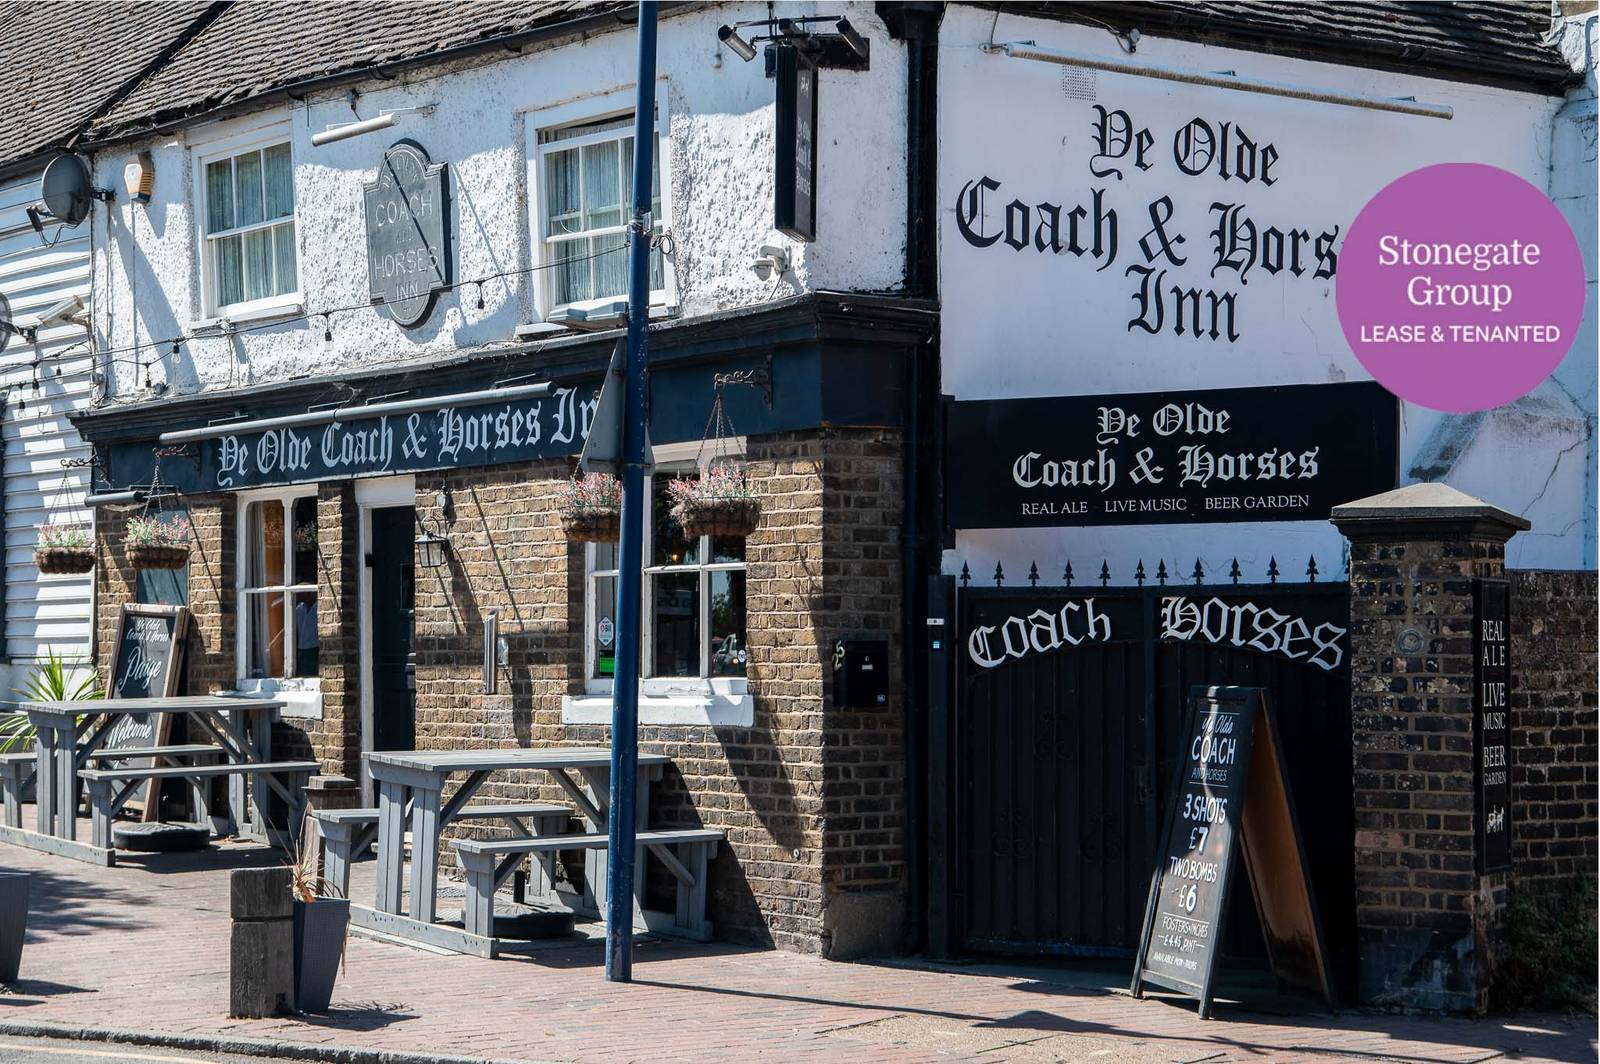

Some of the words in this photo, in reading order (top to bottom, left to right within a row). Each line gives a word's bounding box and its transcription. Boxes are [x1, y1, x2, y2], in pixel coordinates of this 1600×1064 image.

[1090, 104, 1155, 180] Ye
[1173, 117, 1280, 186] Olde
[375, 193, 433, 227] COACH
[956, 176, 1119, 271] Coach
[1138, 194, 1188, 266] &
[1209, 201, 1341, 285] Hors
[374, 245, 439, 279] HORSES
[396, 281, 419, 301] INN
[1125, 264, 1241, 343] Inn
[1096, 405, 1141, 444] Ye
[1153, 402, 1231, 436] Olde
[217, 436, 249, 488] Ye
[256, 427, 313, 474] Olde
[320, 415, 393, 473] Coach
[402, 412, 428, 459] &
[438, 400, 542, 462] Horses
[1012, 449, 1116, 492] Coach
[1128, 446, 1164, 485] &
[1178, 444, 1320, 488] Horses
[1021, 503, 1059, 516] REAL
[1061, 501, 1089, 515] ALE
[1105, 500, 1137, 513] LIVE
[1140, 498, 1188, 512] MUSIC
[1205, 496, 1241, 510] BEER
[1244, 495, 1311, 509] GARDEN
[968, 597, 1112, 669] Coach
[1160, 596, 1347, 672] Horses
[1482, 620, 1506, 641] REAL
[119, 646, 162, 692] Paige
[1482, 645, 1506, 667] ALE
[1483, 683, 1506, 707] LIVE
[107, 713, 152, 750] Welcome
[1483, 712, 1506, 730] MUSIC
[1192, 736, 1236, 764] COACH
[1483, 746, 1506, 768] BEER
[1192, 768, 1205, 779] AND
[1206, 769, 1227, 781] HORSES
[1483, 770, 1507, 787] GARDEN
[1183, 793, 1192, 819] 3
[1192, 795, 1228, 825] SHOTS
[1189, 828, 1209, 852] £7
[1170, 856, 1190, 880] TWO
[1189, 860, 1218, 883] BOMBS
[1178, 884, 1197, 913] £6
